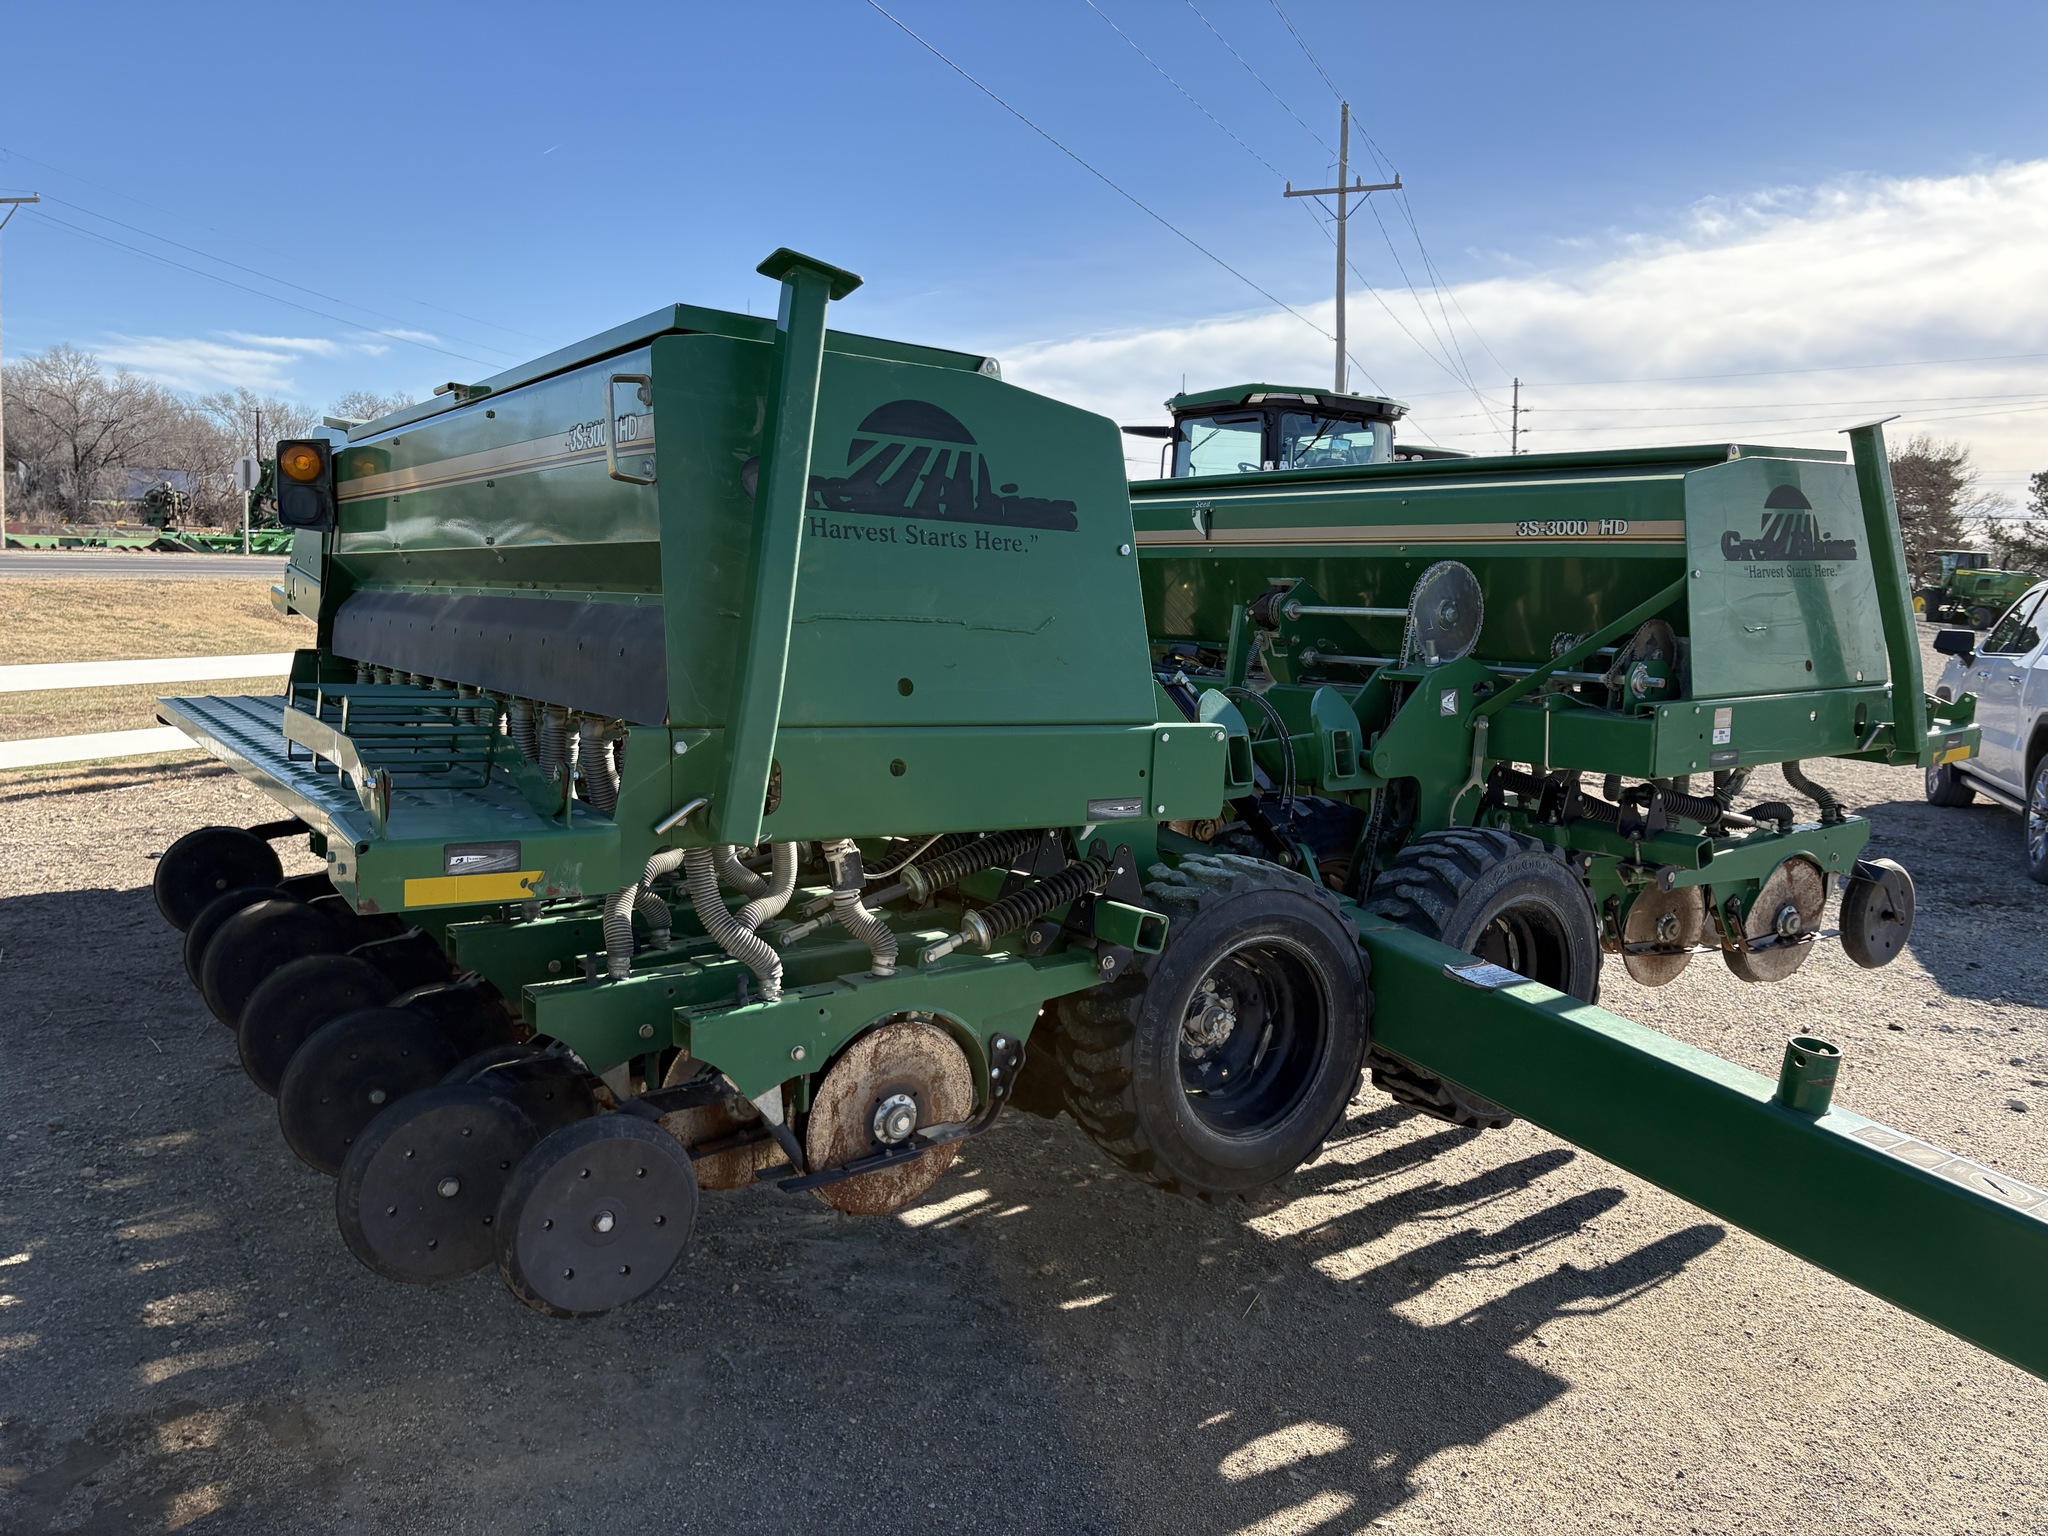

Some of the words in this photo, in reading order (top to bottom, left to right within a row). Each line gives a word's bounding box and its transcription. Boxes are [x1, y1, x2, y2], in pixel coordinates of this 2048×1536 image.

[568, 422, 608, 451] 3S-300
[619, 414, 639, 443] HD
[1195, 500, 1211, 508] Seed
[905, 525, 967, 549] Starts
[1516, 519, 1588, 537] 3S-3000
[1598, 518, 1629, 536] HD
[1786, 564, 1812, 578] Starts
